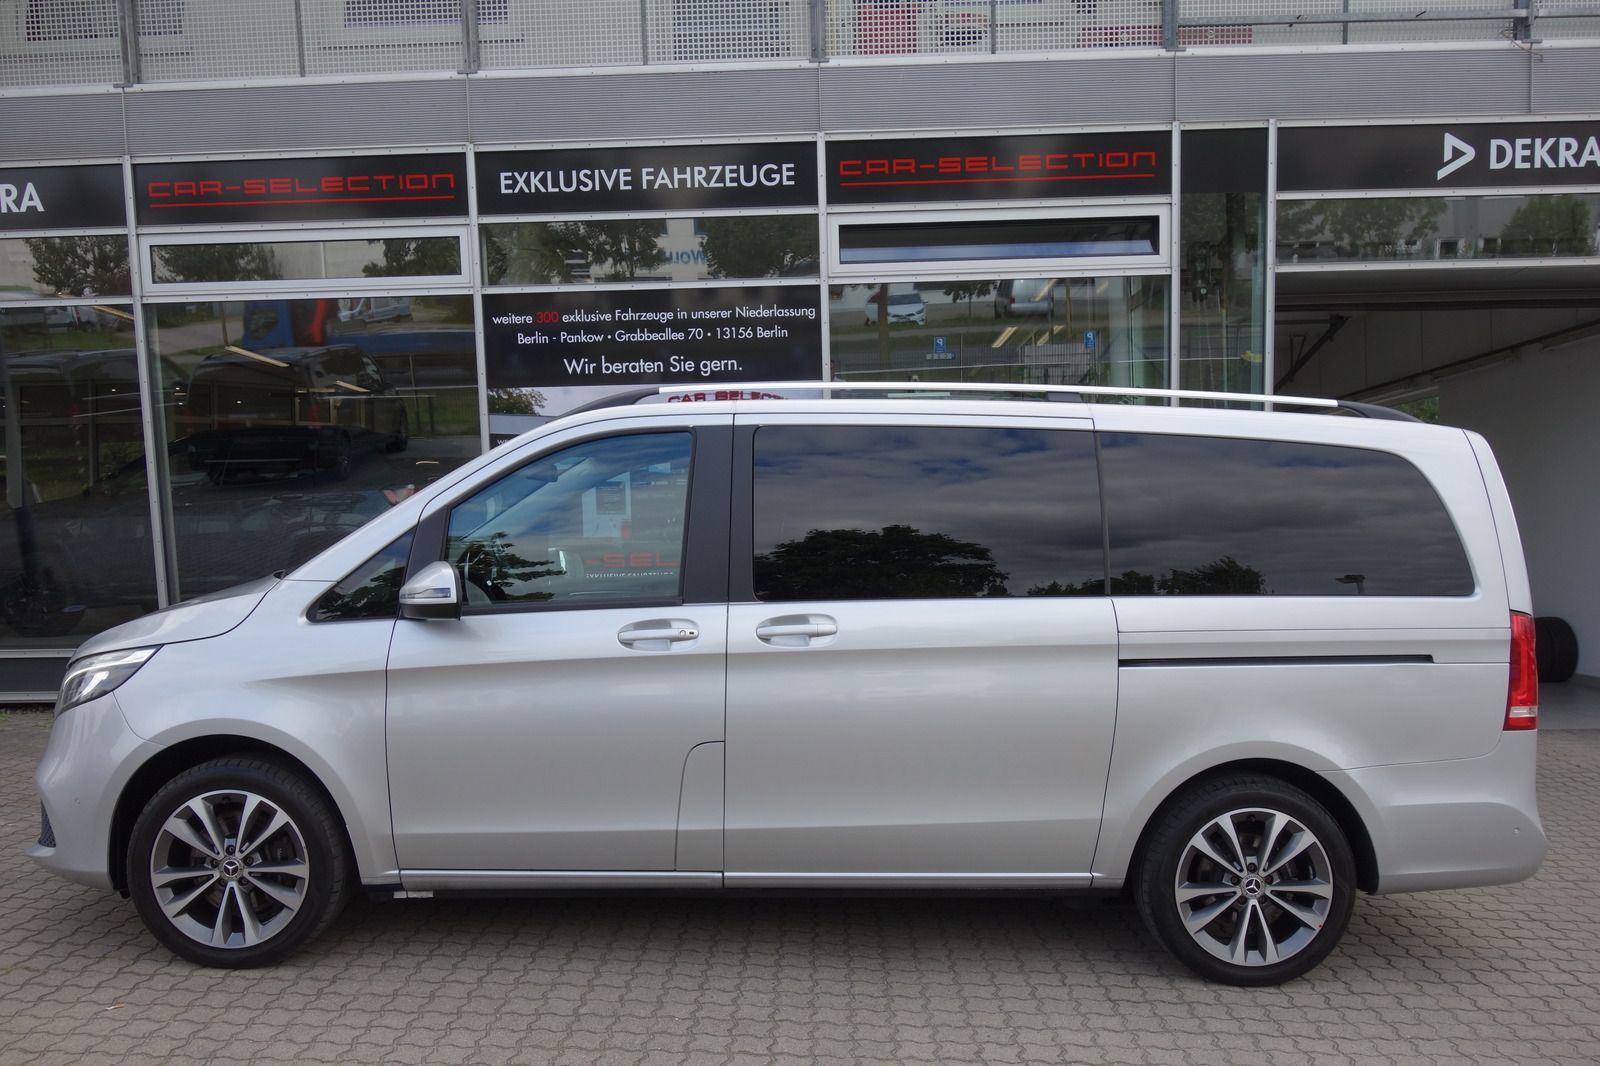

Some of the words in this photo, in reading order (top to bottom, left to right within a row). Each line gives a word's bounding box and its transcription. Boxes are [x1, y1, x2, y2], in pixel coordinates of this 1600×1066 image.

[839, 151, 1156, 176] CAR-SELECTION
[1490, 136, 1600, 169] DEKRA
[148, 172, 455, 197] CAR-SELECTION
[500, 168, 632, 194] EXKLUSIVE
[641, 163, 795, 190] FAHRZEUGE
[492, 313, 533, 324] weitere
[536, 311, 560, 323] 300
[562, 309, 612, 322] exklusive
[615, 307, 674, 323] Fahrzeuge
[677, 308, 688, 320] in
[691, 310, 732, 319] unserer
[735, 304, 816, 320] Niederlassung
[517, 330, 549, 345] Berlin
[560, 330, 604, 344] Pankow
[615, 327, 685, 342] Grabbeallee
[688, 327, 703, 340] 70
[716, 327, 754, 339] 13156
[756, 324, 789, 338] Berlin
[563, 358, 597, 375] Wir
[602, 355, 664, 374] beraten
[670, 355, 695, 372] Sie
[700, 358, 743, 376] gern.
